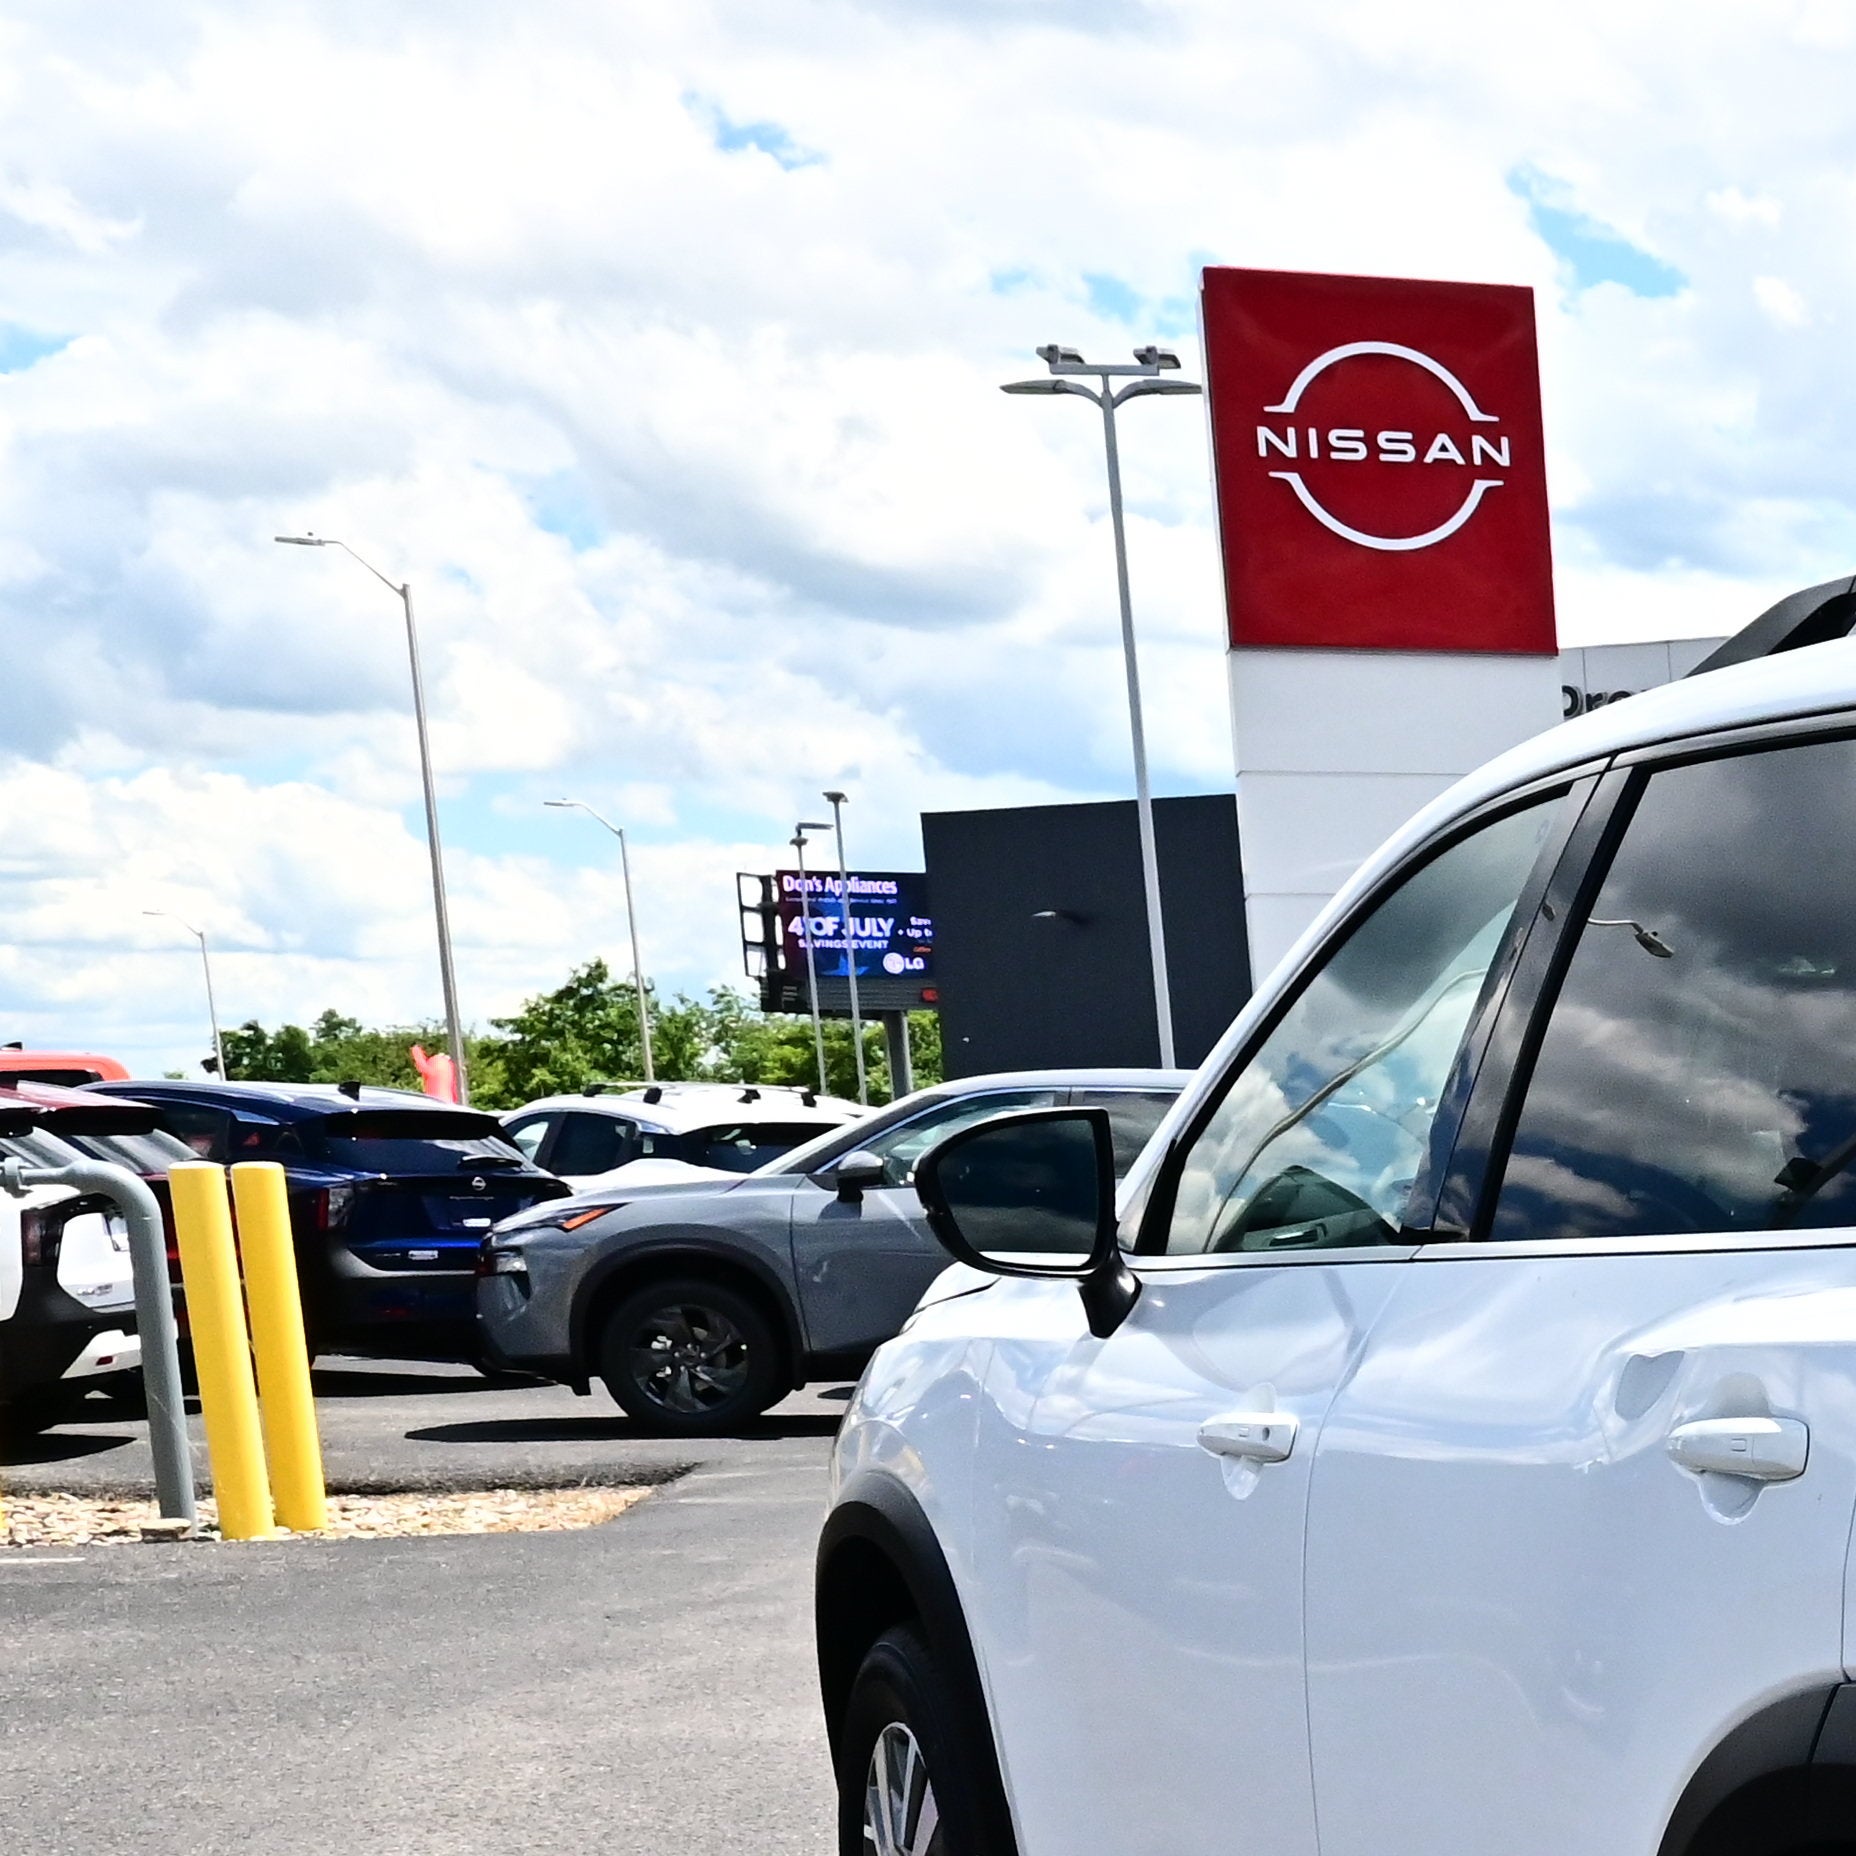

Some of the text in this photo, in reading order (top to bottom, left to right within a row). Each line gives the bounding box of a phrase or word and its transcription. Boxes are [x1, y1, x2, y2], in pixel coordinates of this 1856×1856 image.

[1256, 425, 1511, 467] NISSAN
[783, 875, 823, 892] Don's
[808, 916, 839, 936] OF
[841, 917, 894, 937] JULY
[851, 940, 889, 949] EVENT
[905, 957, 925, 969] LG
